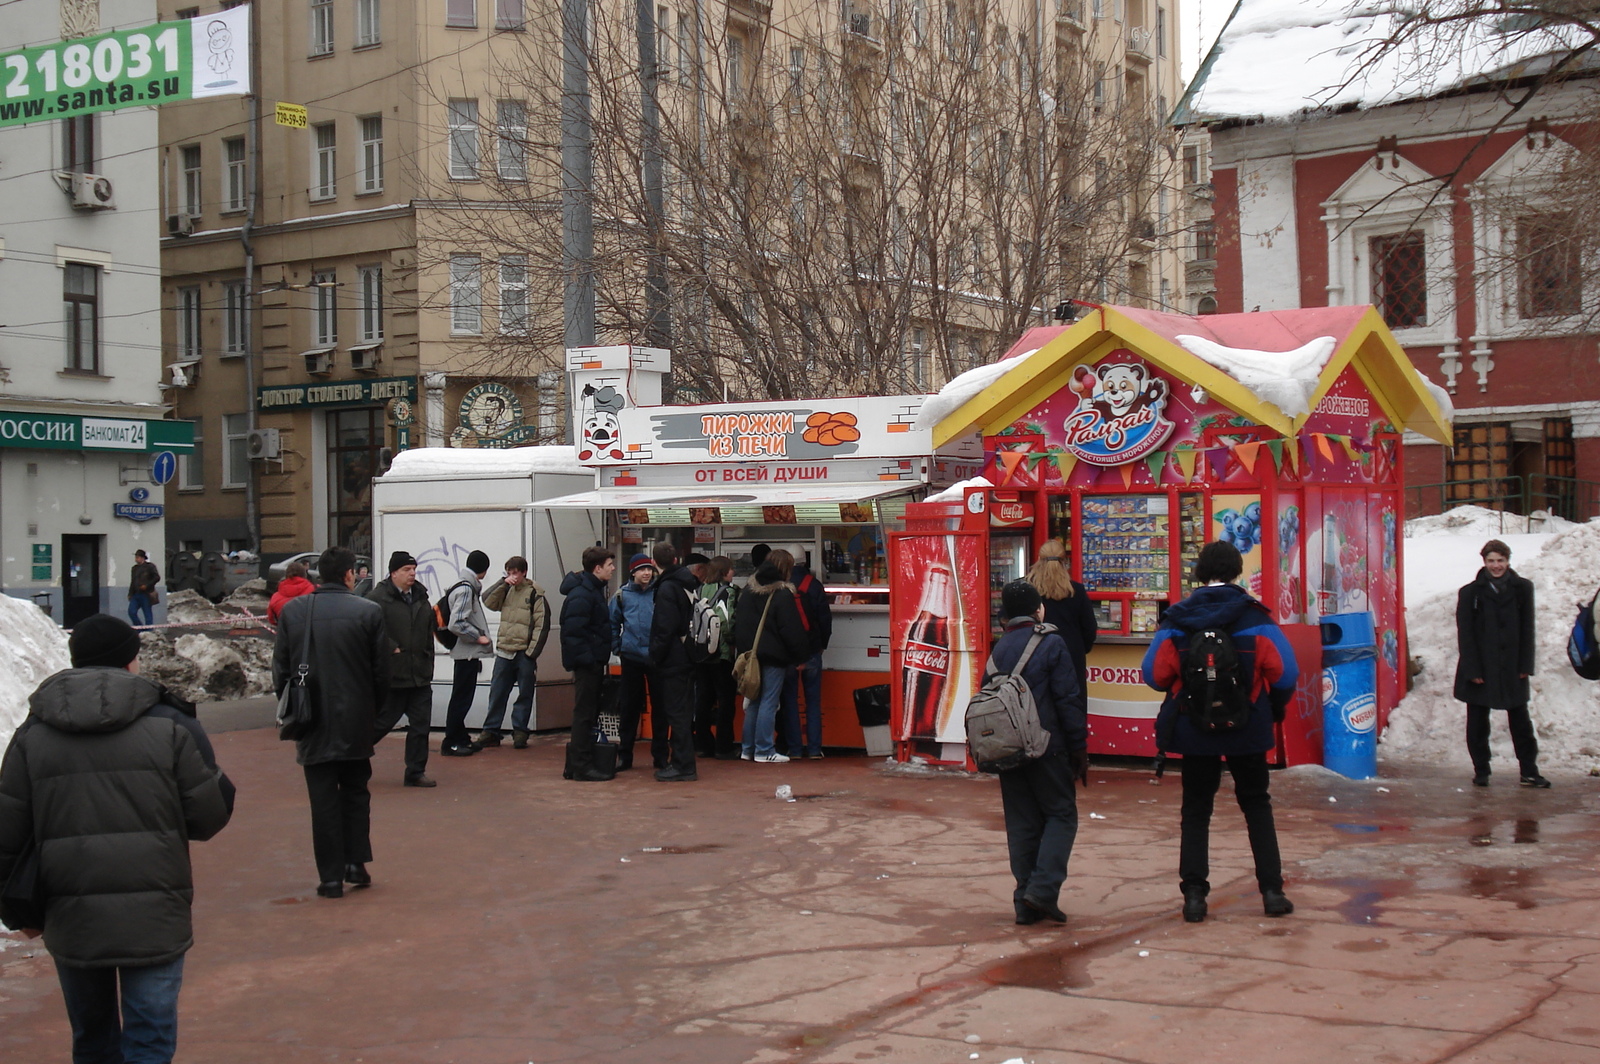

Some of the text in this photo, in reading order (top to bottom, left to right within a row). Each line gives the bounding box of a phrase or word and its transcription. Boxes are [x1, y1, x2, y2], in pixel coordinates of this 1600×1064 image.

[5, 28, 179, 98] 218031
[276, 111, 307, 127] 739-59-59
[261, 380, 409, 407] ДОКТОР СТОЛЕТОВ ДИЕТА
[0, 418, 76, 442] ОССИИ
[84, 425, 144, 444] БАНКОМАТ 24
[701, 411, 795, 437] ПИРОЖКИ
[1065, 407, 1153, 449] Рамзай
[709, 434, 787, 457] ИЗ ПЕЧИ
[1079, 426, 1165, 463] НАСТОЯЩЕЕ МОРОЖЕНОЕ
[695, 465, 828, 483] ОТ ВСЕЙ ДУШИ
[954, 465, 968, 478] ОТ
[138, 490, 144, 499] 5
[120, 506, 160, 514] ОСТОЖЕНКА
[906, 646, 948, 670] Coca-Cola
